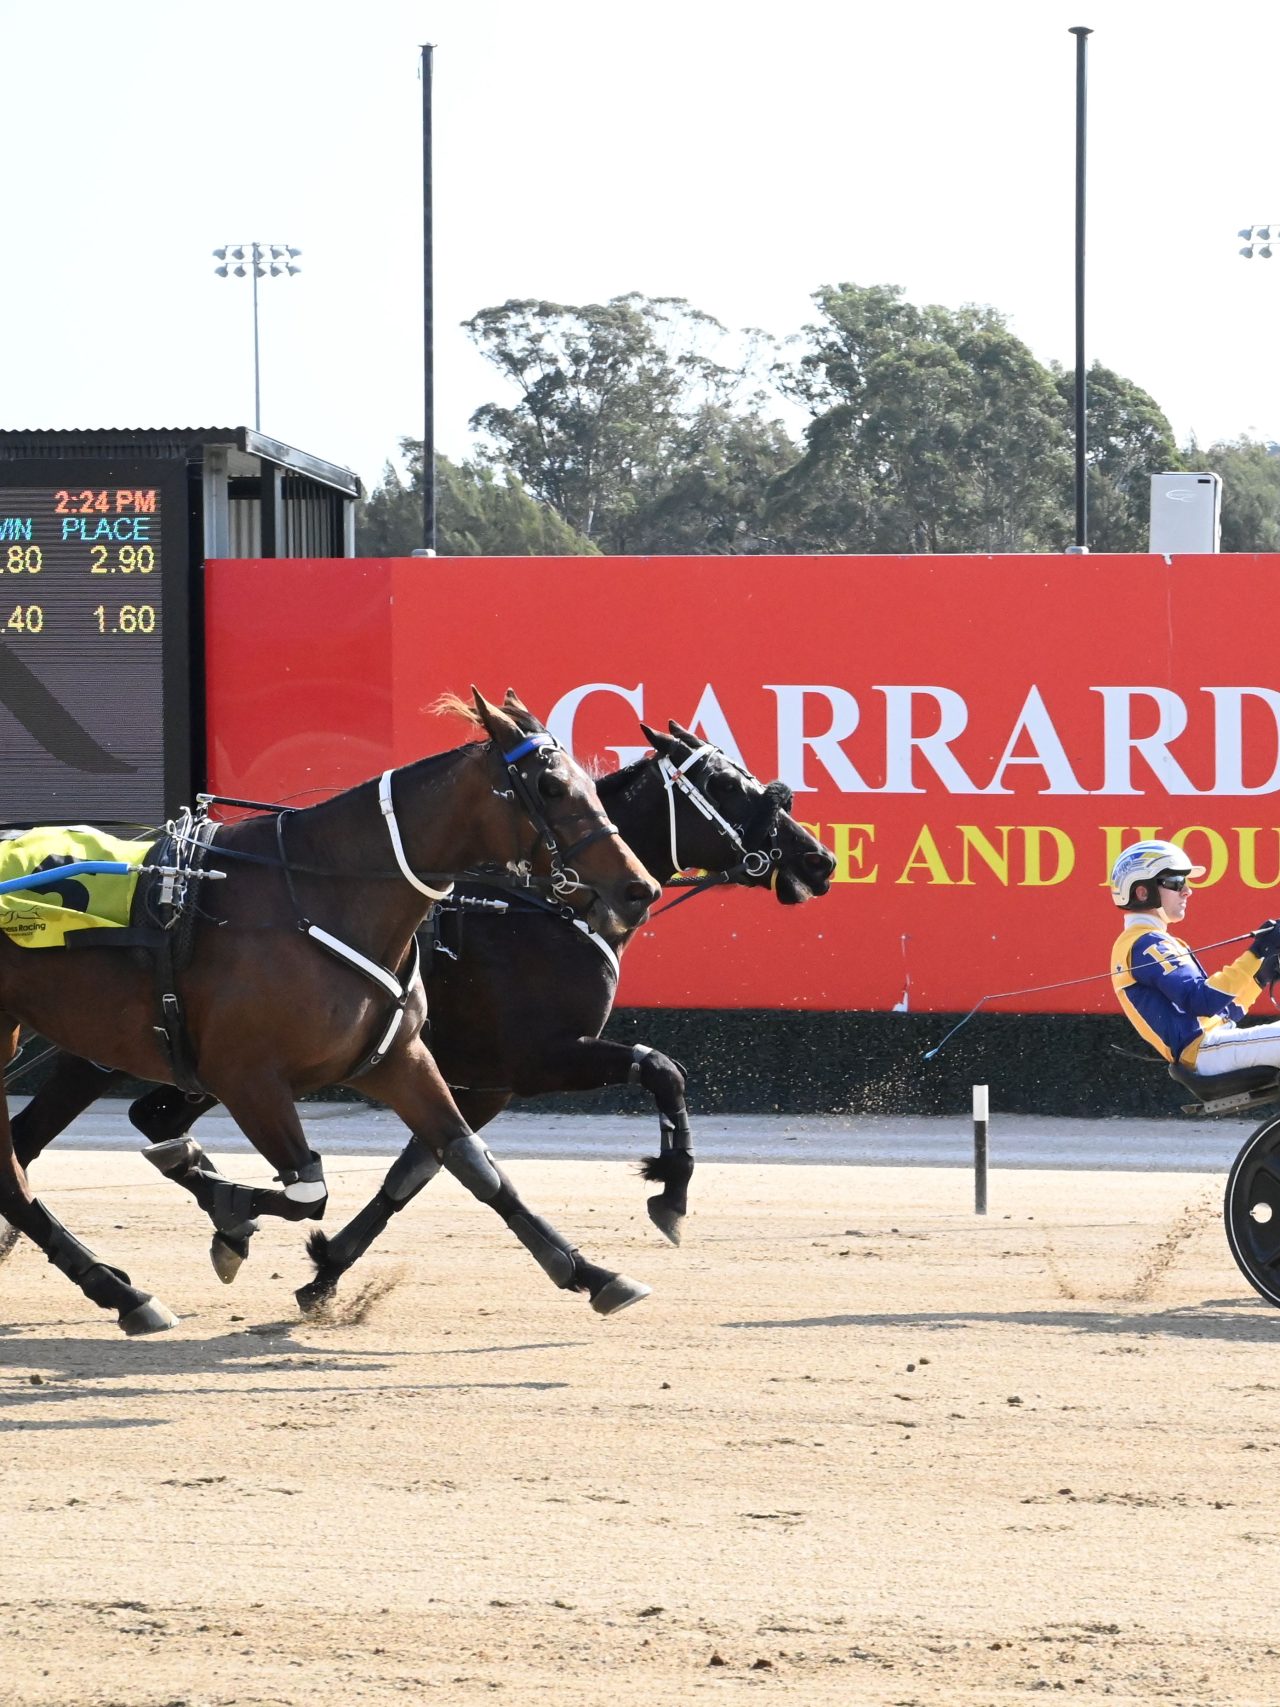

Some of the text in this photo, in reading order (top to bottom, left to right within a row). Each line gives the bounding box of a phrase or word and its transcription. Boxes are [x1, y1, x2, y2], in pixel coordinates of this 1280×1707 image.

[54, 490, 156, 514] 2:24 PM
[62, 517, 151, 541] PLACE
[90, 545, 155, 574] 2.90
[93, 605, 156, 633] 1.60
[895, 824, 1076, 887] AND
[18, 922, 46, 932] Racing
